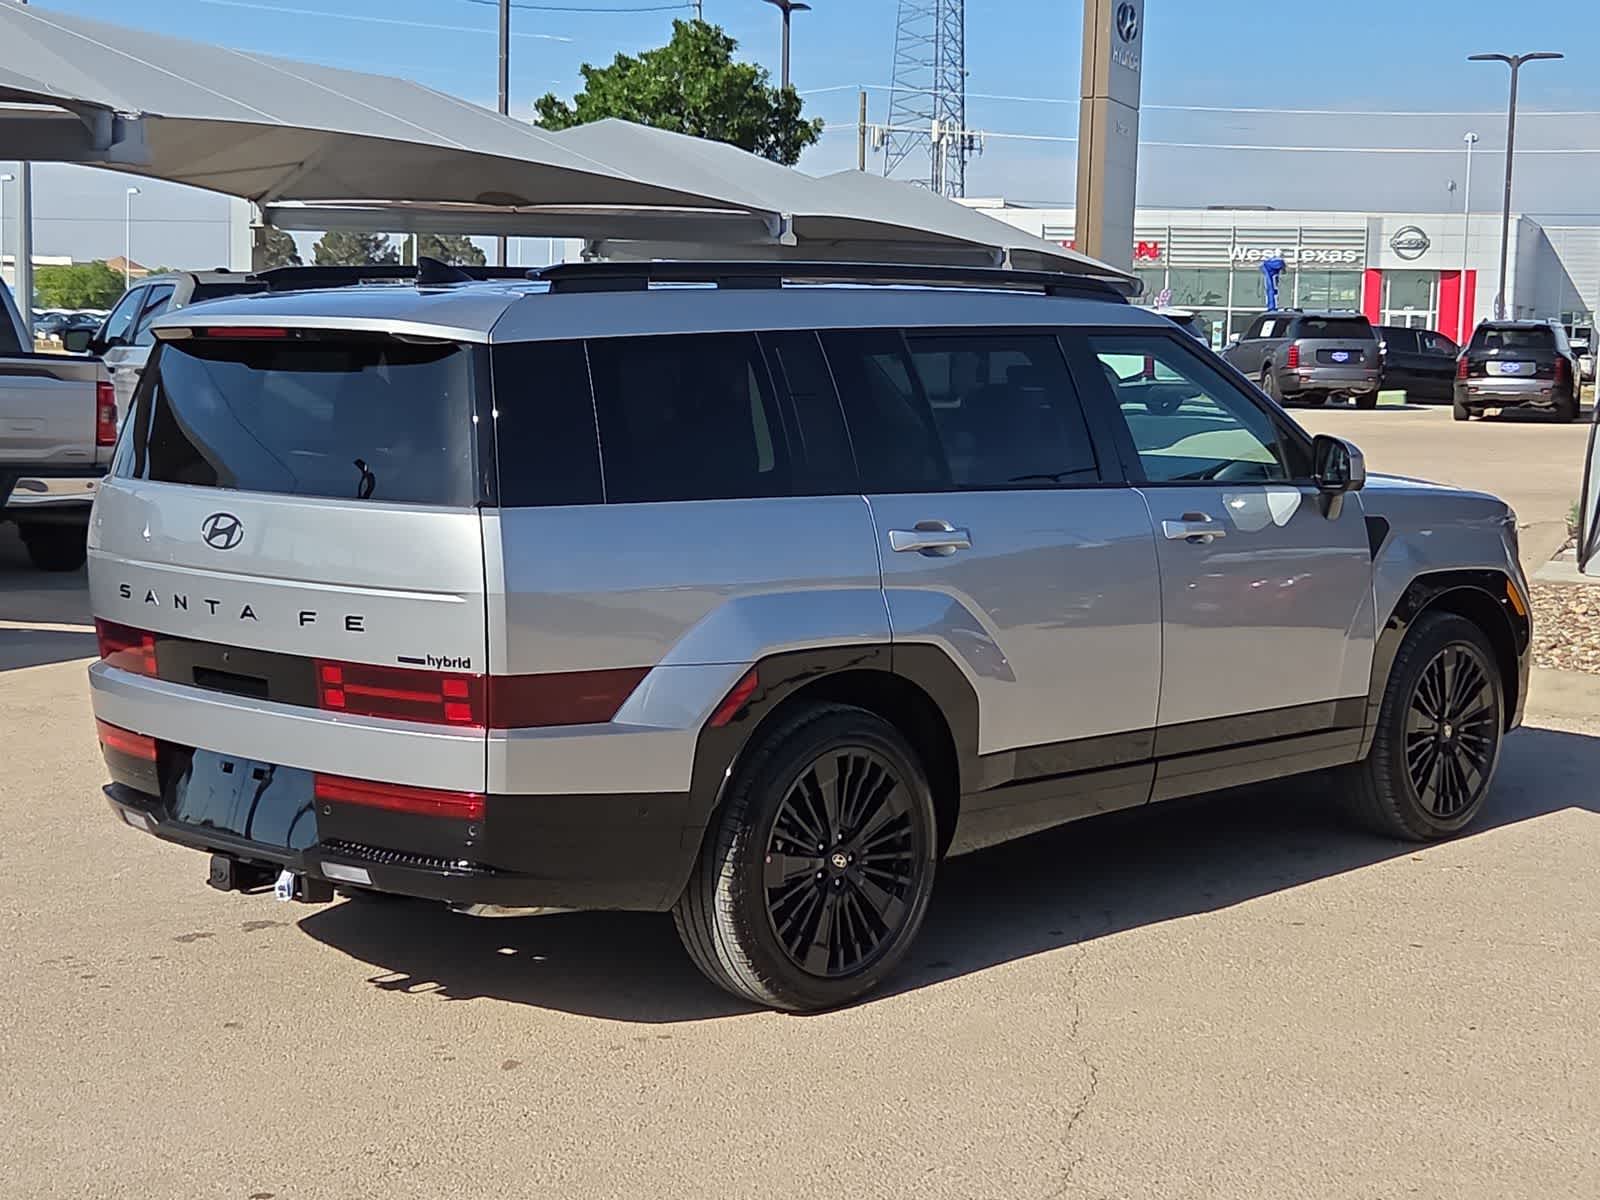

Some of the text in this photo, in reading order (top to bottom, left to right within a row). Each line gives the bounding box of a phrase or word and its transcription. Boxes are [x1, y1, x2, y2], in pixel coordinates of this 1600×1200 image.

[1228, 246, 1357, 262] West Texas
[119, 583, 365, 632] SANTA FE
[426, 653, 471, 670] hybrid
